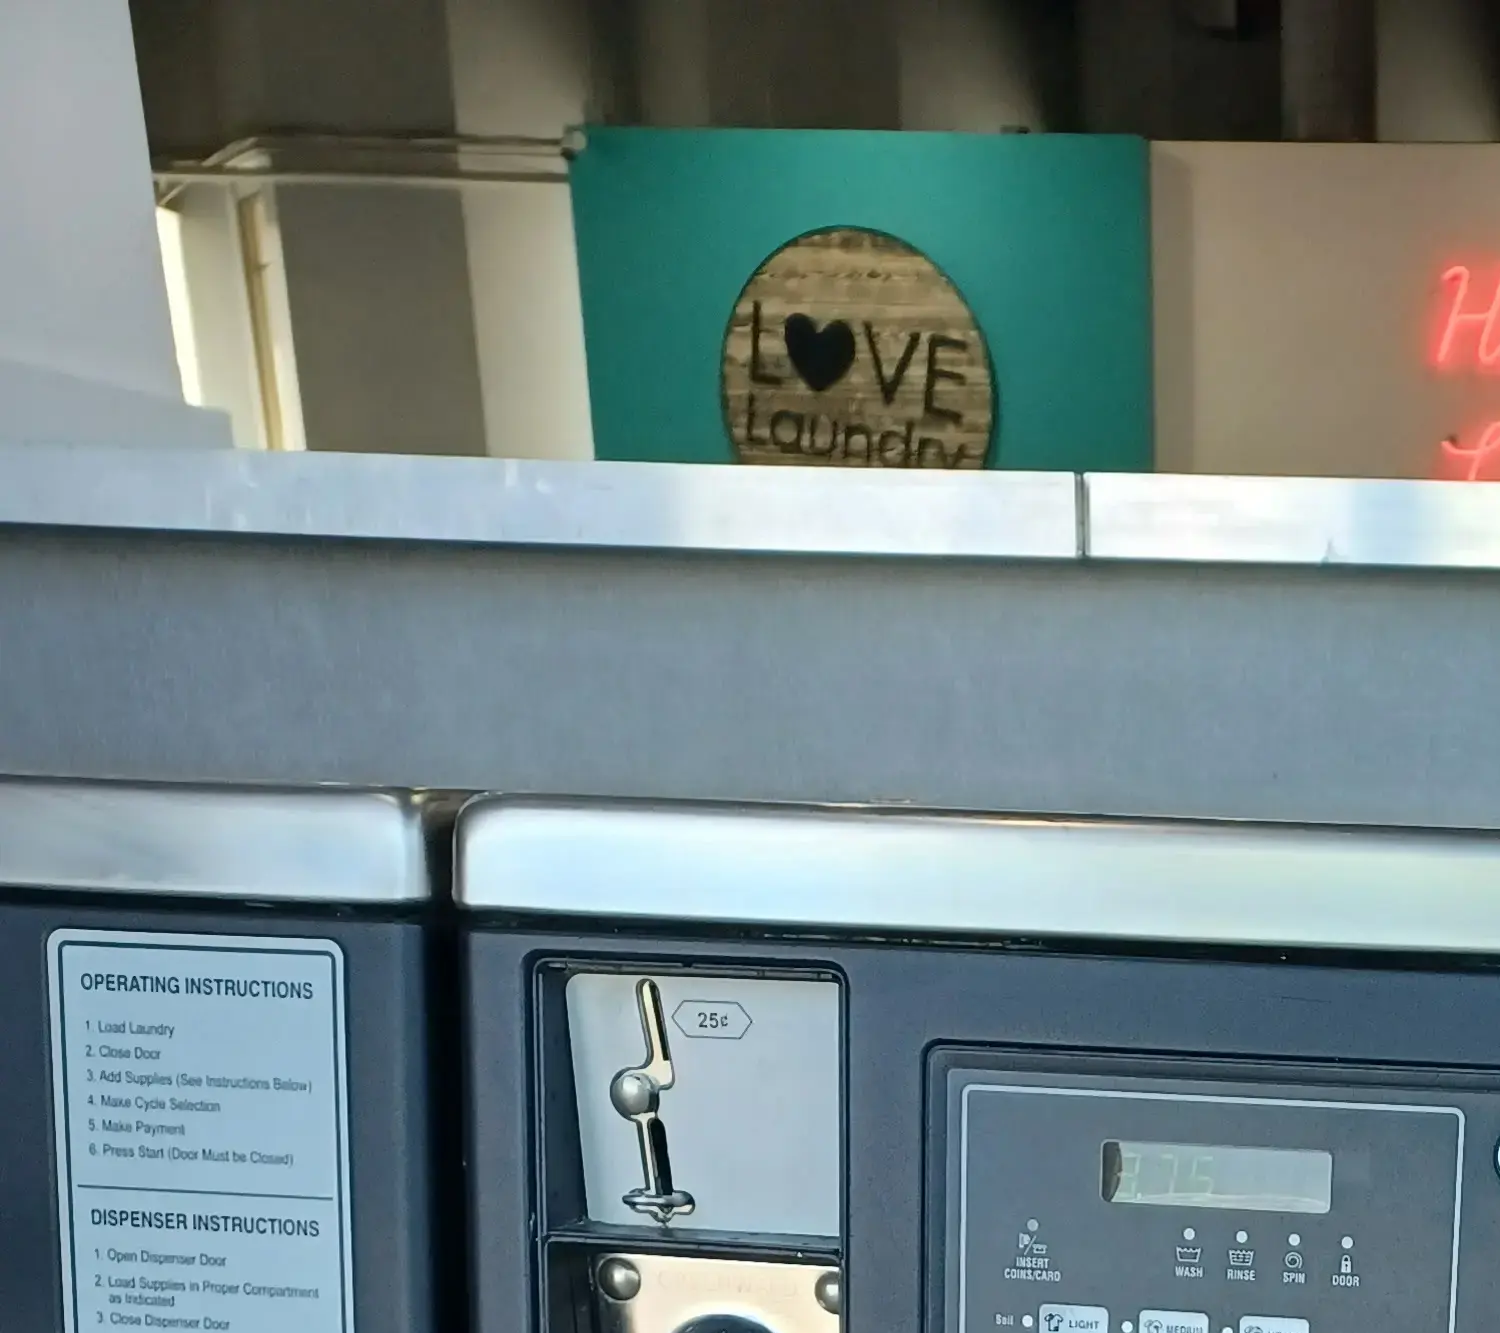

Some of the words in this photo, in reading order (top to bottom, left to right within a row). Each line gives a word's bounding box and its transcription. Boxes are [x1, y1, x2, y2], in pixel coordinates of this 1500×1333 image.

[80, 973, 180, 994] OPERATING
[185, 977, 313, 999] INSTRUCTIONS
[98, 1021, 125, 1034] Load
[129, 1022, 174, 1038] Laundry
[99, 1045, 131, 1058] Close
[135, 1047, 161, 1060] Door
[102, 1120, 132, 1133] Make
[136, 1121, 185, 1137] Payment
[91, 1209, 187, 1230] DISPENSER
[193, 1214, 320, 1237] INSTRUCTIONS
[1016, 1257, 1050, 1268] INSERT
[1004, 1268, 1061, 1282] COINS/CARD
[1176, 1266, 1203, 1277] WASH
[1227, 1269, 1256, 1281] RINSE
[1283, 1272, 1305, 1284] SPIN
[1332, 1275, 1360, 1287] DOOR
[1069, 1320, 1099, 1330] LIGHT
